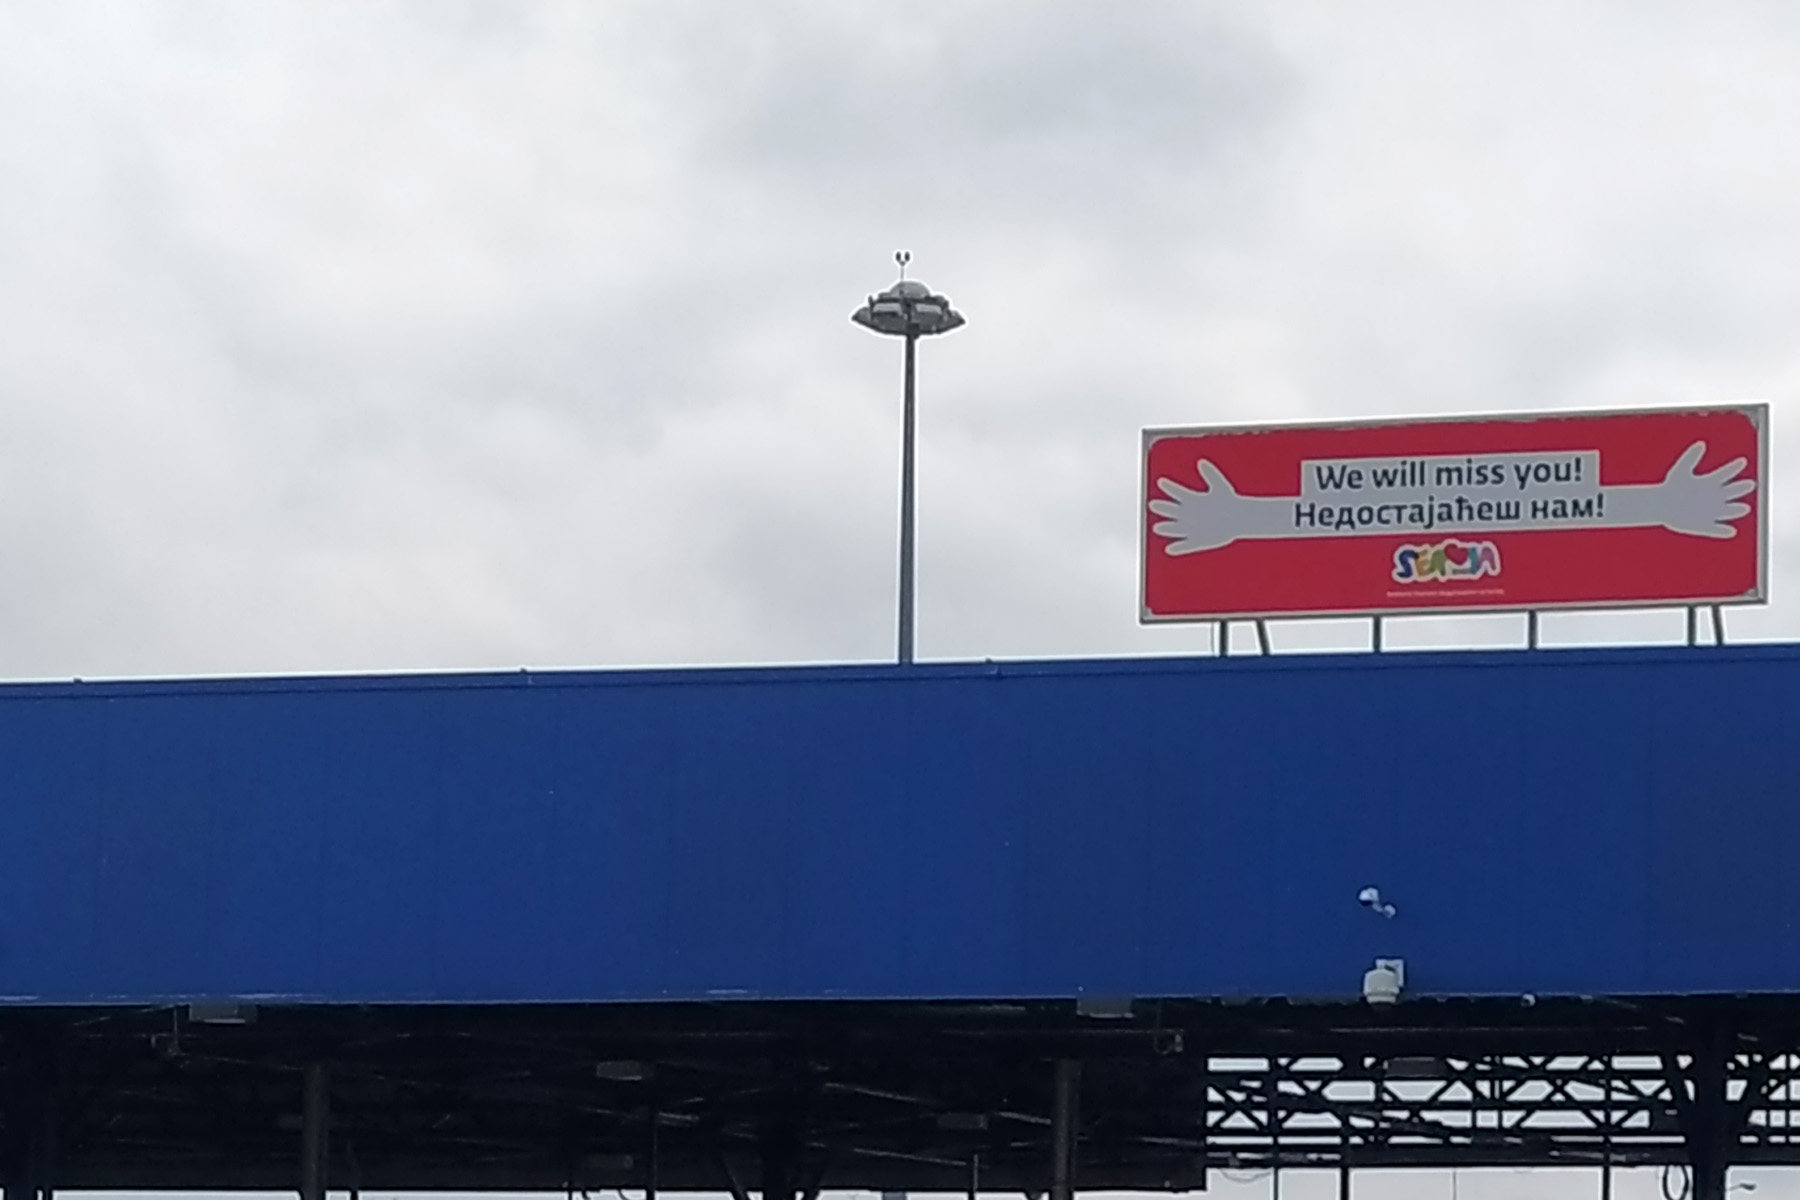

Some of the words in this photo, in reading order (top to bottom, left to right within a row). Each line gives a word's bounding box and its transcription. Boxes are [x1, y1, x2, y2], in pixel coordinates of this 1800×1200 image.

[1316, 464, 1363, 490] We
[1372, 460, 1425, 488] will
[1436, 457, 1505, 486] miss
[1514, 457, 1581, 490] you!
[1295, 496, 1520, 530] Недостајаћеш
[1531, 493, 1604, 520] нам!
